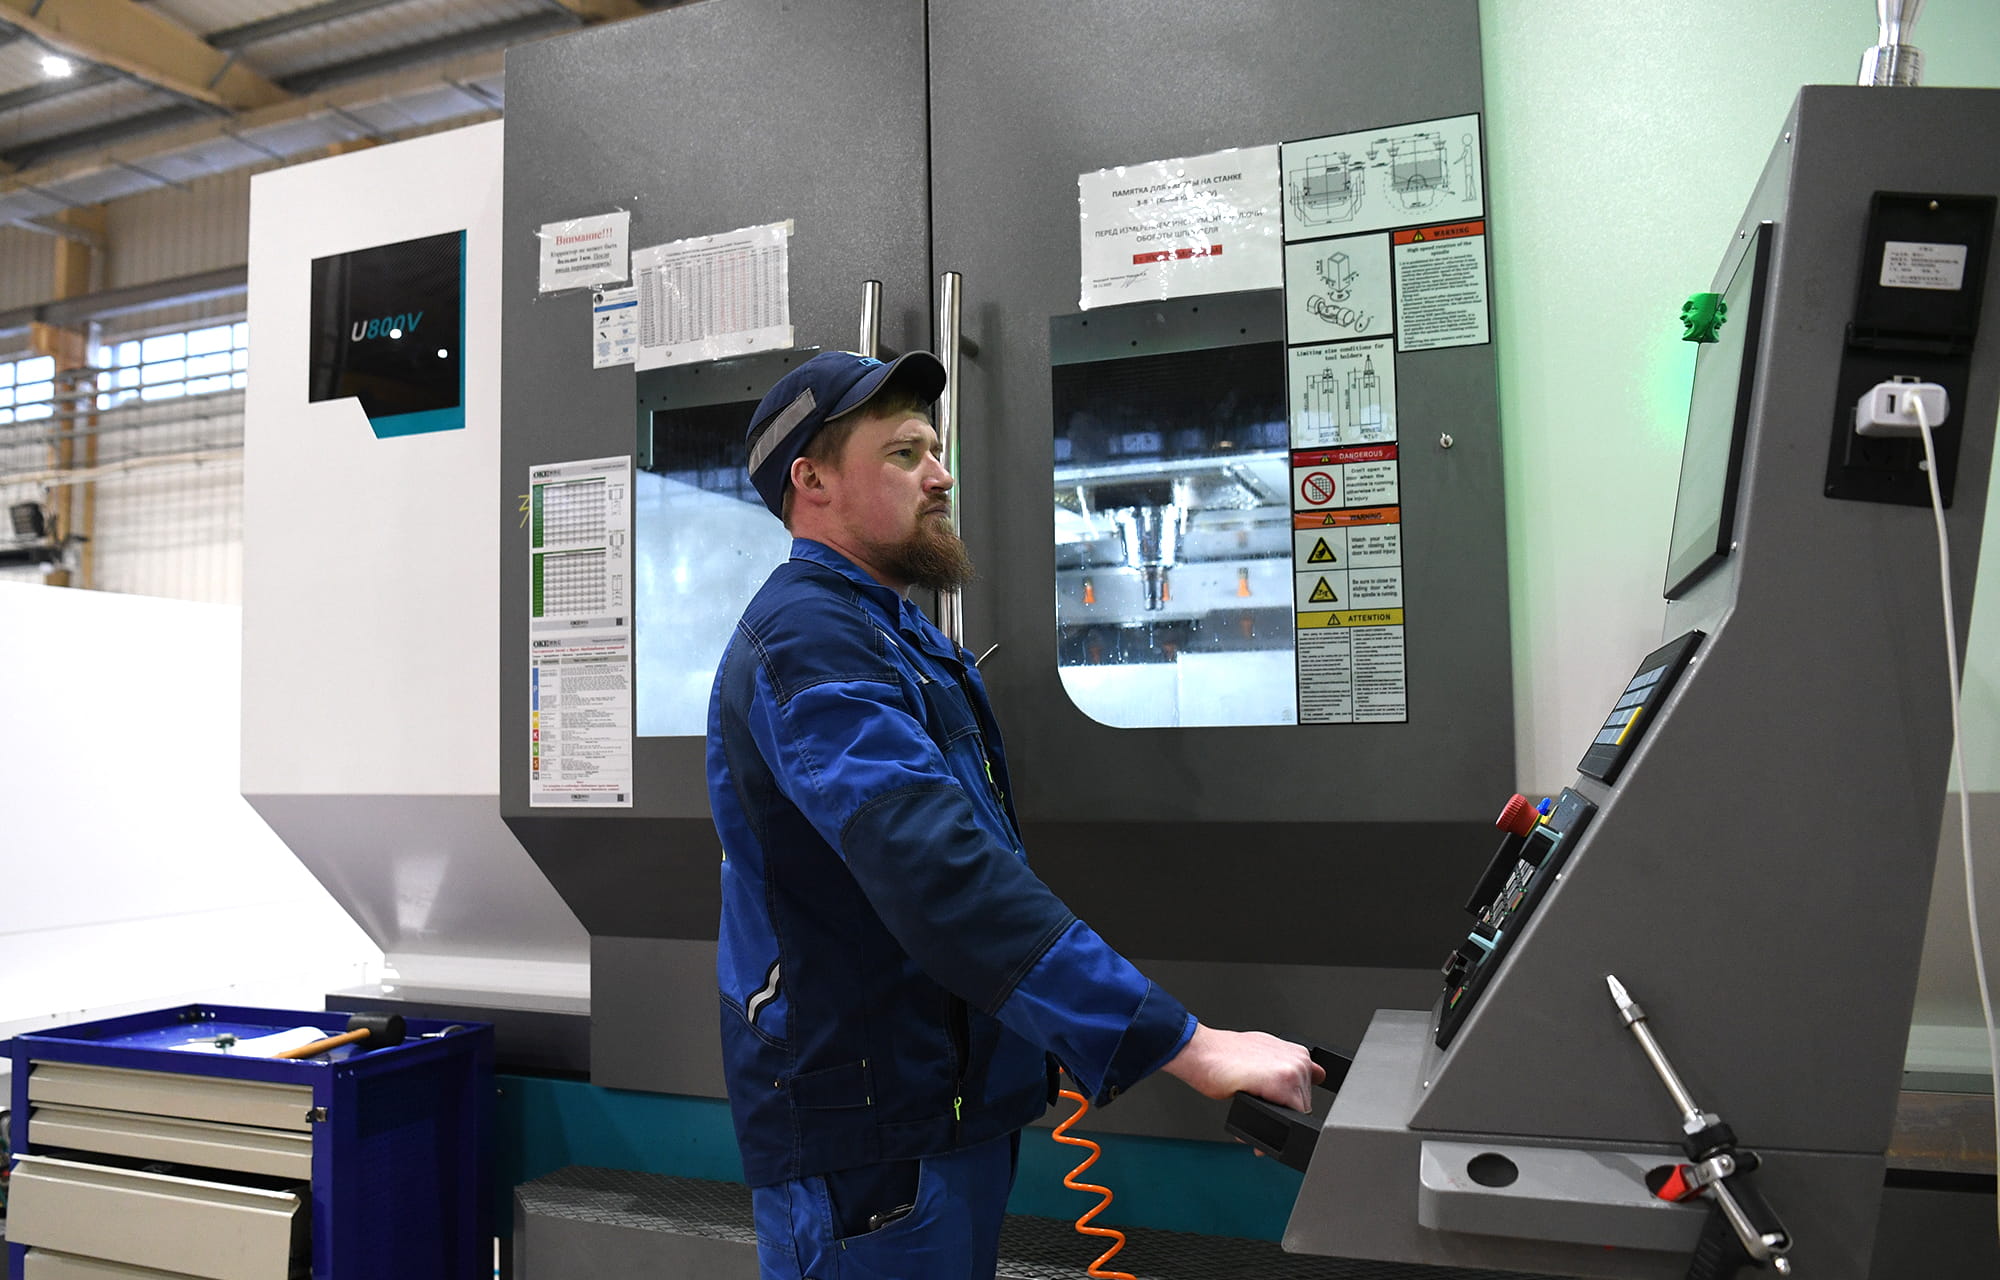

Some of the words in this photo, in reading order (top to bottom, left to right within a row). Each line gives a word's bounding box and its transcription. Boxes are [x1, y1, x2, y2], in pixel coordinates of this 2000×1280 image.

[1112, 186, 1148, 198] ПАМЯТКА
[1213, 172, 1242, 184] СТАНКЕ
[556, 228, 613, 245] Внимание!!!
[1094, 228, 1119, 238] ПЕРЕД
[1434, 227, 1469, 236] WARNING
[351, 311, 424, 342] U800V
[1296, 349, 1323, 358] Limiting
[1340, 344, 1372, 352] conditions
[1339, 450, 1383, 459] DANGEROUS
[1348, 613, 1391, 622] ATTENTION
